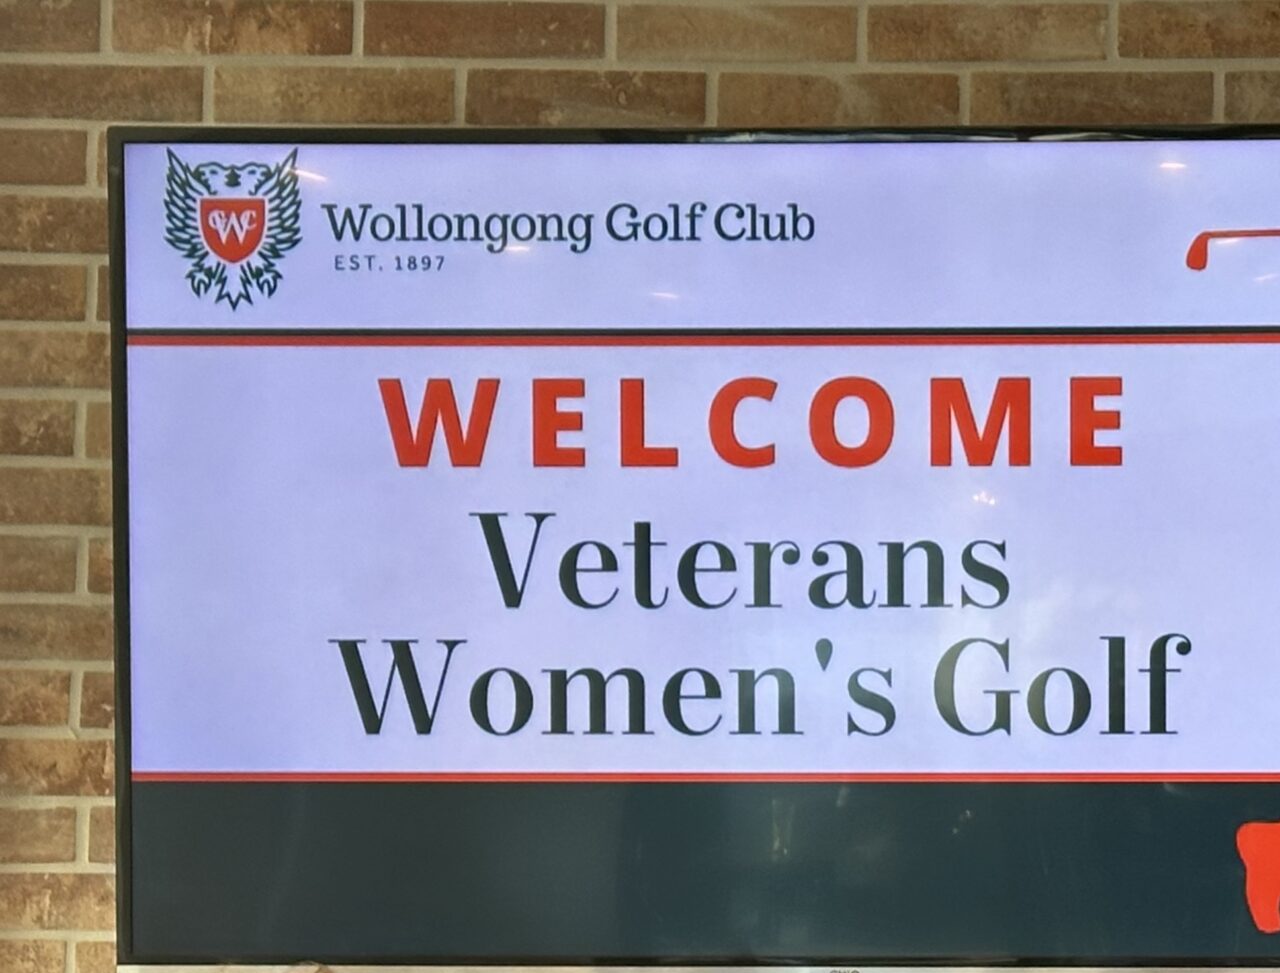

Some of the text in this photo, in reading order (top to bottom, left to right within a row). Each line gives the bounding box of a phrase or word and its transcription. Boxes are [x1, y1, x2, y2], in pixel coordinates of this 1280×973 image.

[320, 201, 815, 251] Wollongong Golf Club
[334, 254, 445, 272] EST. 1897
[377, 375, 1125, 470] WELCOME
[468, 511, 1012, 611] Veterans
[327, 632, 1193, 738] Women's Golf
